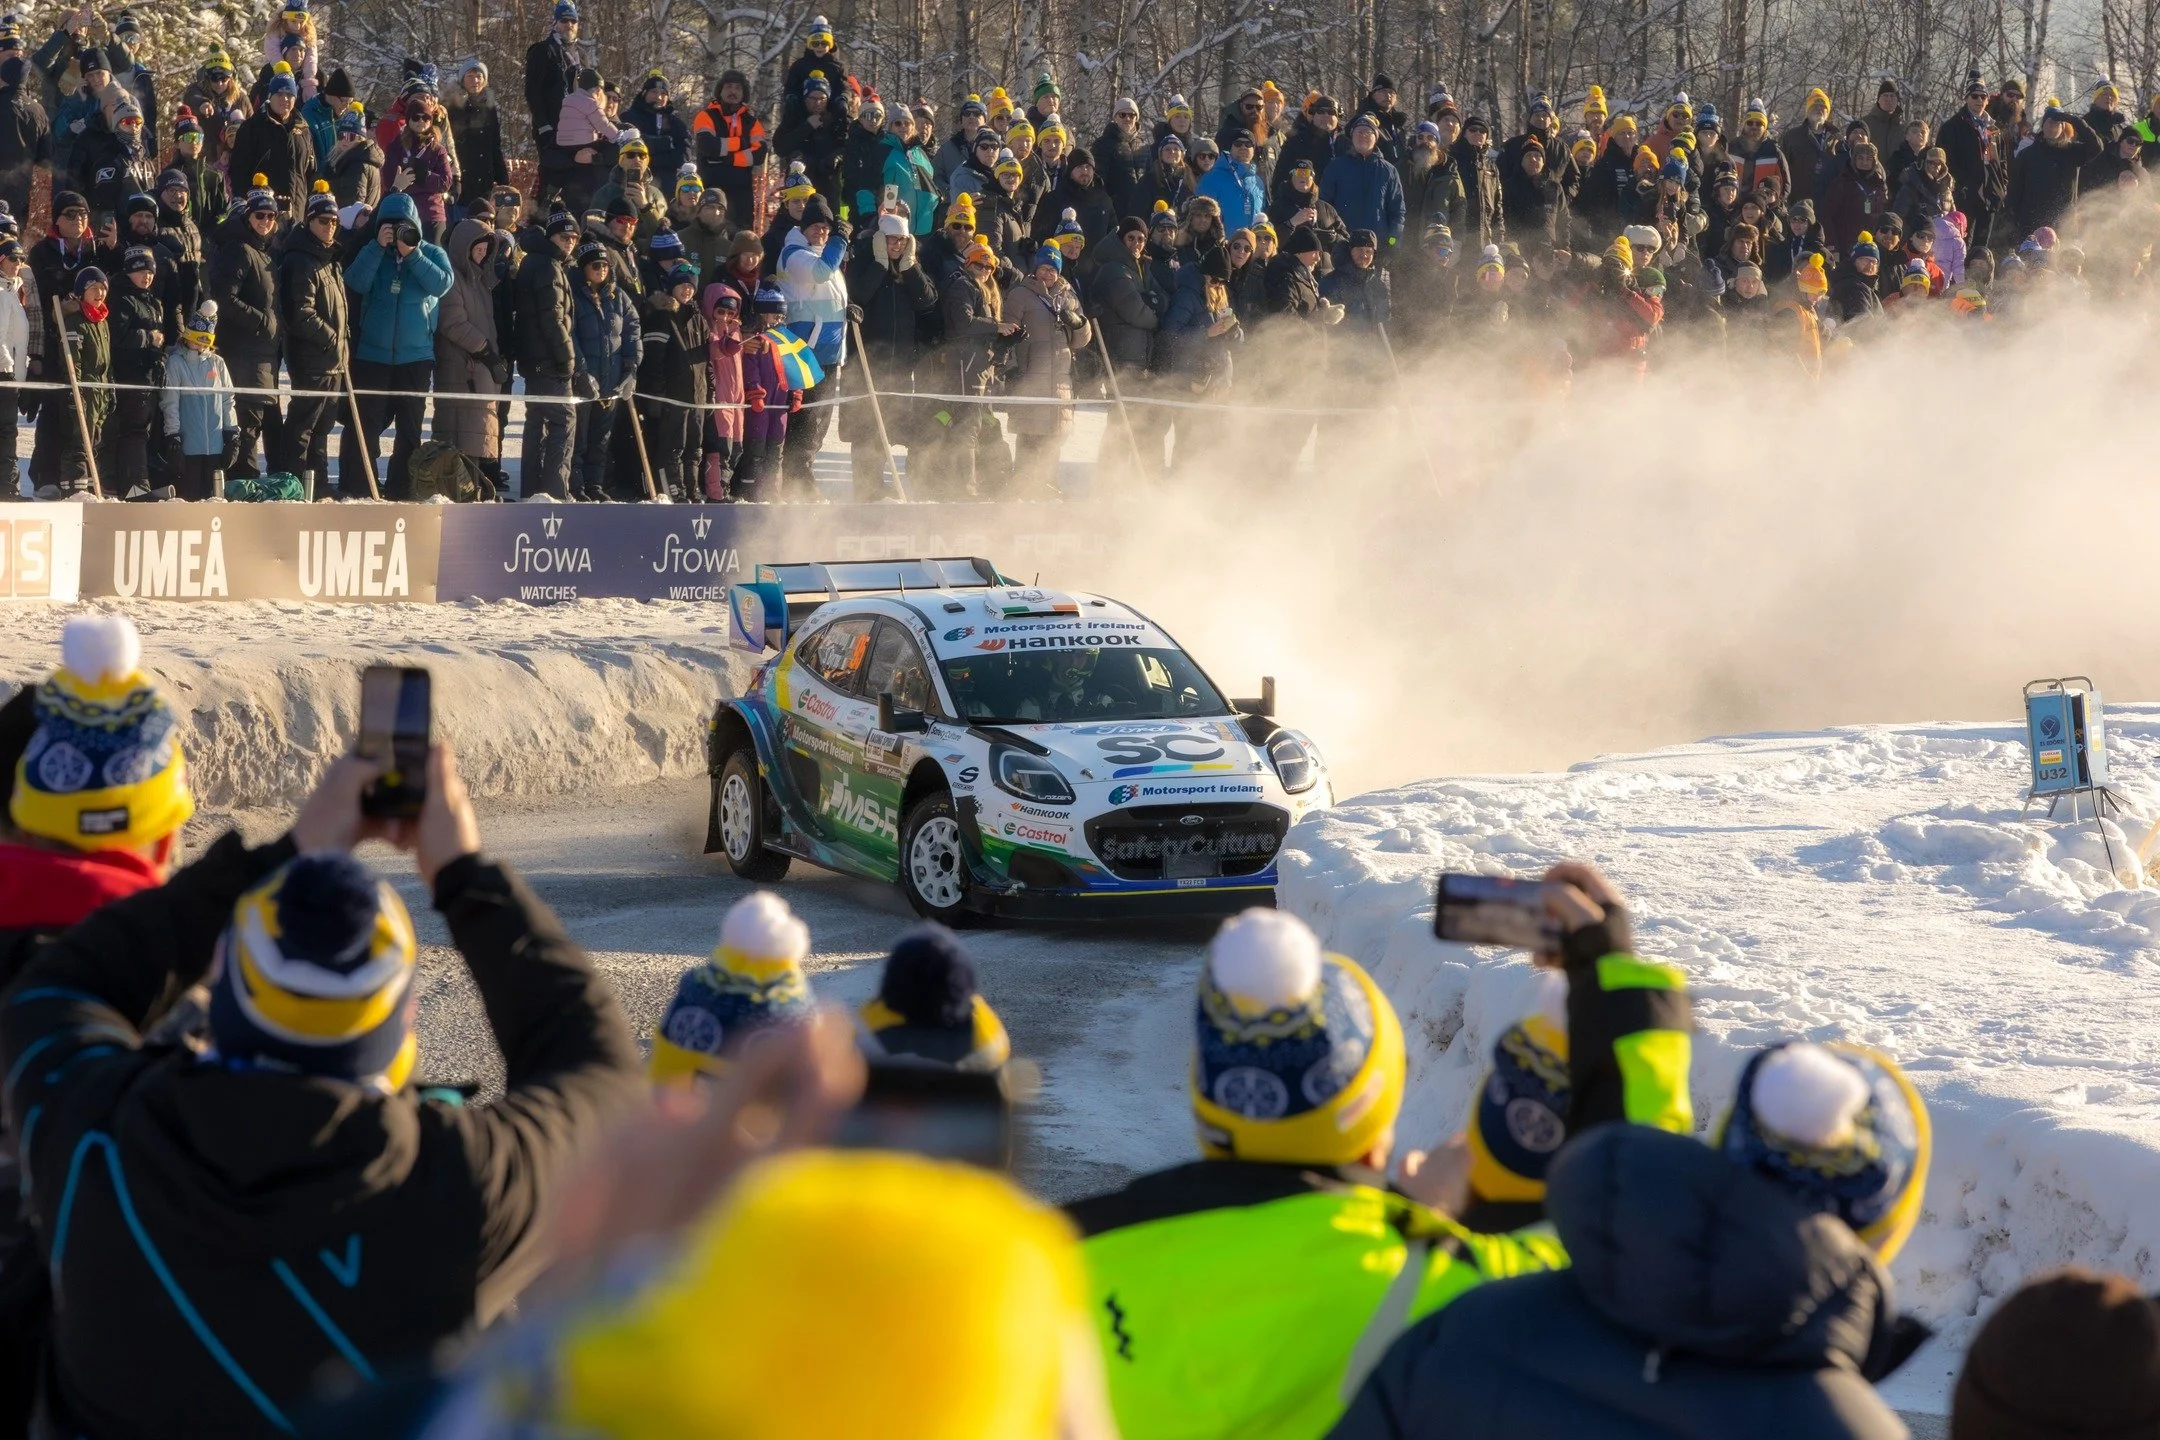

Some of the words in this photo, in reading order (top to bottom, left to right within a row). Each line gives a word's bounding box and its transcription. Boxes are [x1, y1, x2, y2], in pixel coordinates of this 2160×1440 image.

[0, 531, 44, 581] S
[113, 516, 229, 597] UMEÅ
[299, 517, 409, 597] UMEÅ
[504, 532, 592, 574] STOWA
[653, 532, 740, 574] STOWA
[520, 585, 577, 600] WATCHES
[669, 585, 726, 600] WATCHES
[984, 622, 1082, 635] Motorsport
[1087, 621, 1146, 631] Ireland
[807, 693, 841, 721] Castrol
[1096, 723, 1170, 735] Ford
[792, 725, 830, 754] Motorsport
[829, 745, 854, 765] Ireland
[1097, 734, 1225, 765] SC
[2039, 768, 2067, 780] U32
[1142, 785, 1216, 797] Motorsport
[1220, 784, 1264, 794] Ireland
[1016, 825, 1067, 845] Castrol
[1102, 832, 1277, 864] SafetyCulture
